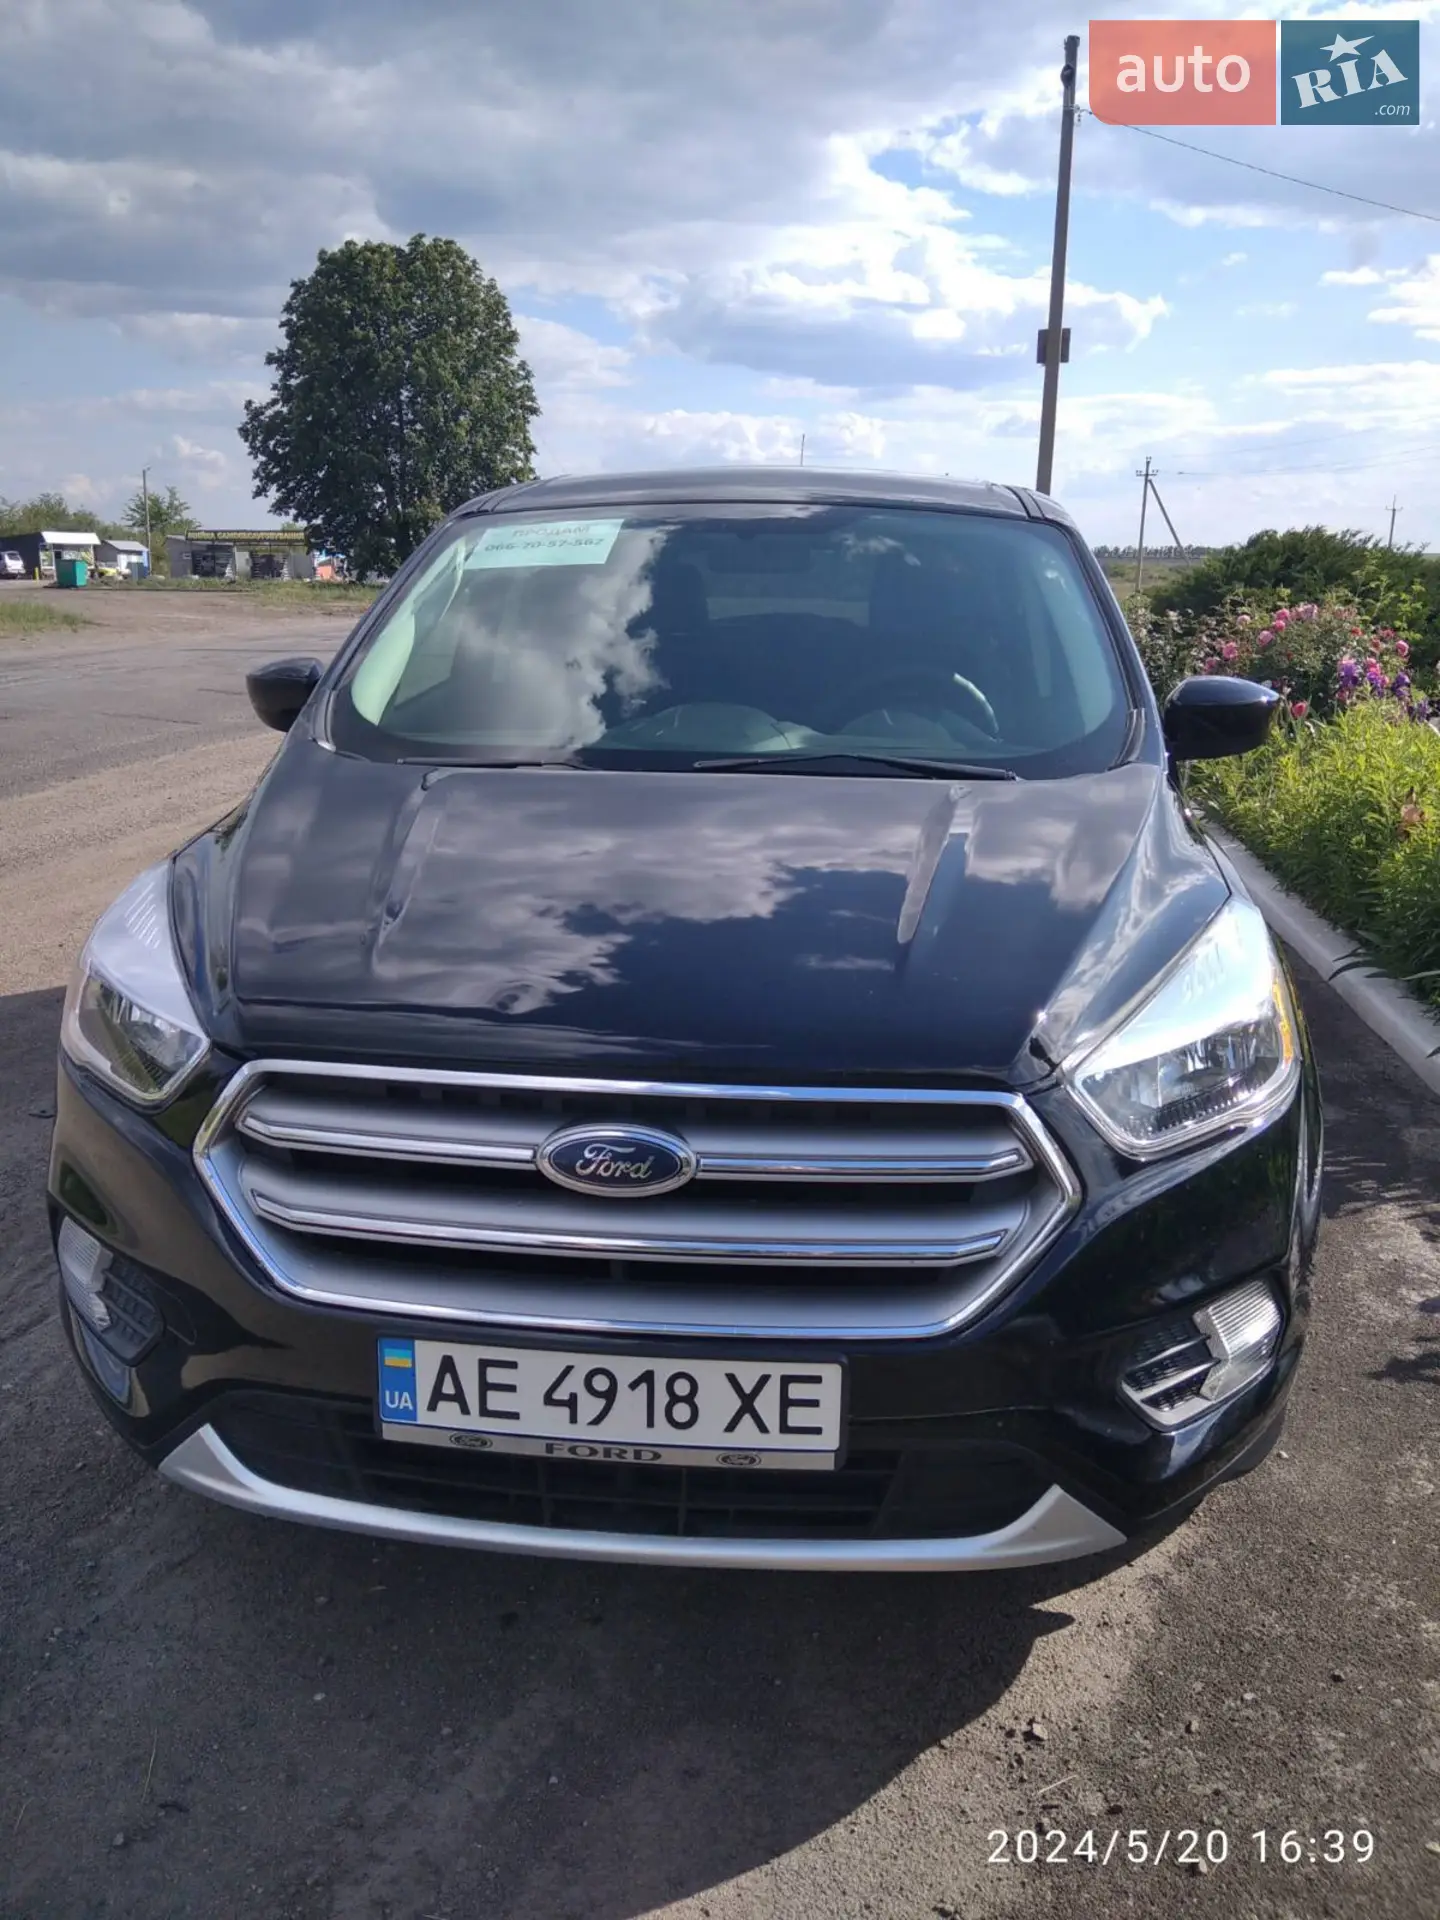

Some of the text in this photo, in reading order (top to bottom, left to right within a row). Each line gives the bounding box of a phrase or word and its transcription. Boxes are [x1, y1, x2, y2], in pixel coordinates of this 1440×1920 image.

[575, 1143, 655, 1179] Ford
[385, 1390, 413, 1411] UA
[426, 1354, 823, 1435] AE 4918 XE
[545, 1442, 662, 1462] FORD
